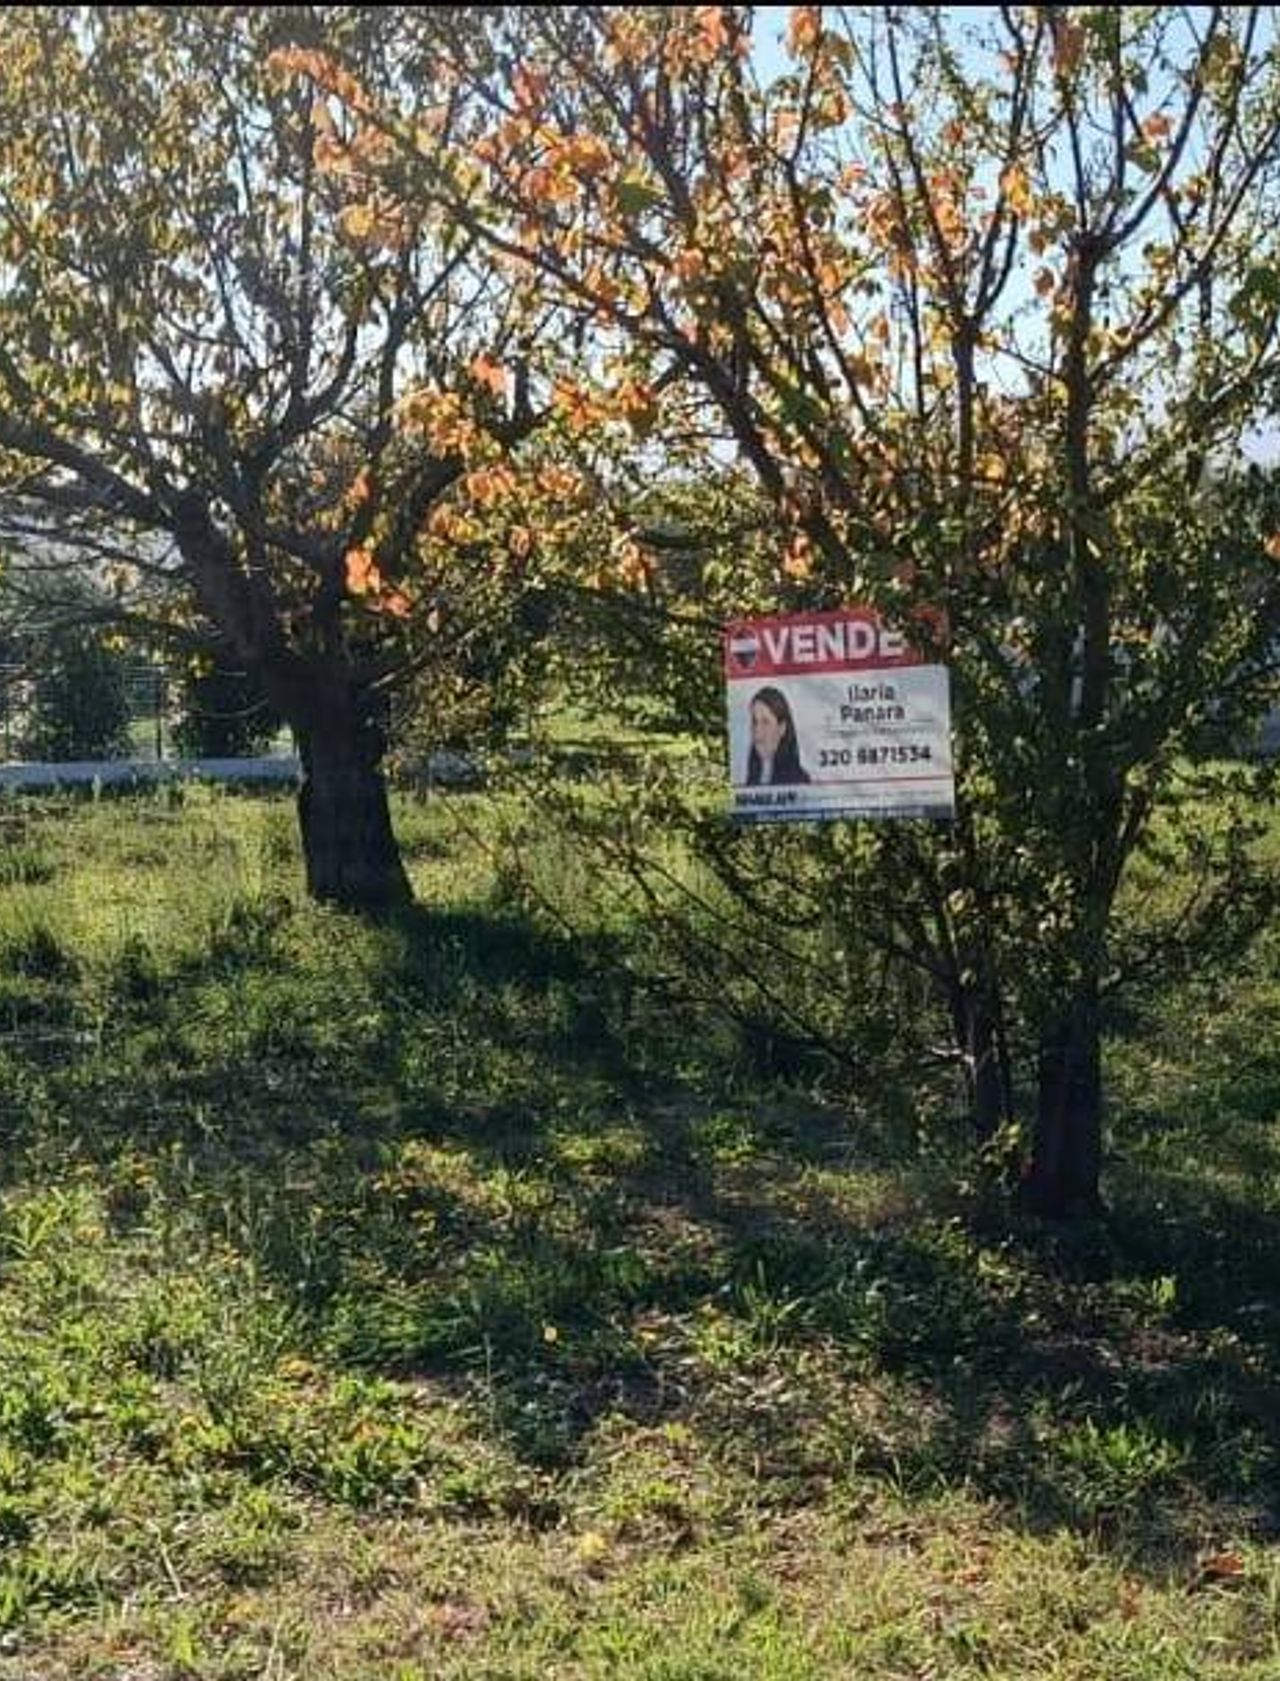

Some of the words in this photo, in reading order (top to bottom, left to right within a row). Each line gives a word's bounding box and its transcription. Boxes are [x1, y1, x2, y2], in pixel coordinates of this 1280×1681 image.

[763, 621, 904, 665] VENDE
[848, 684, 895, 703] Ilaria
[839, 705, 905, 723] Panara
[819, 749, 852, 767] 320
